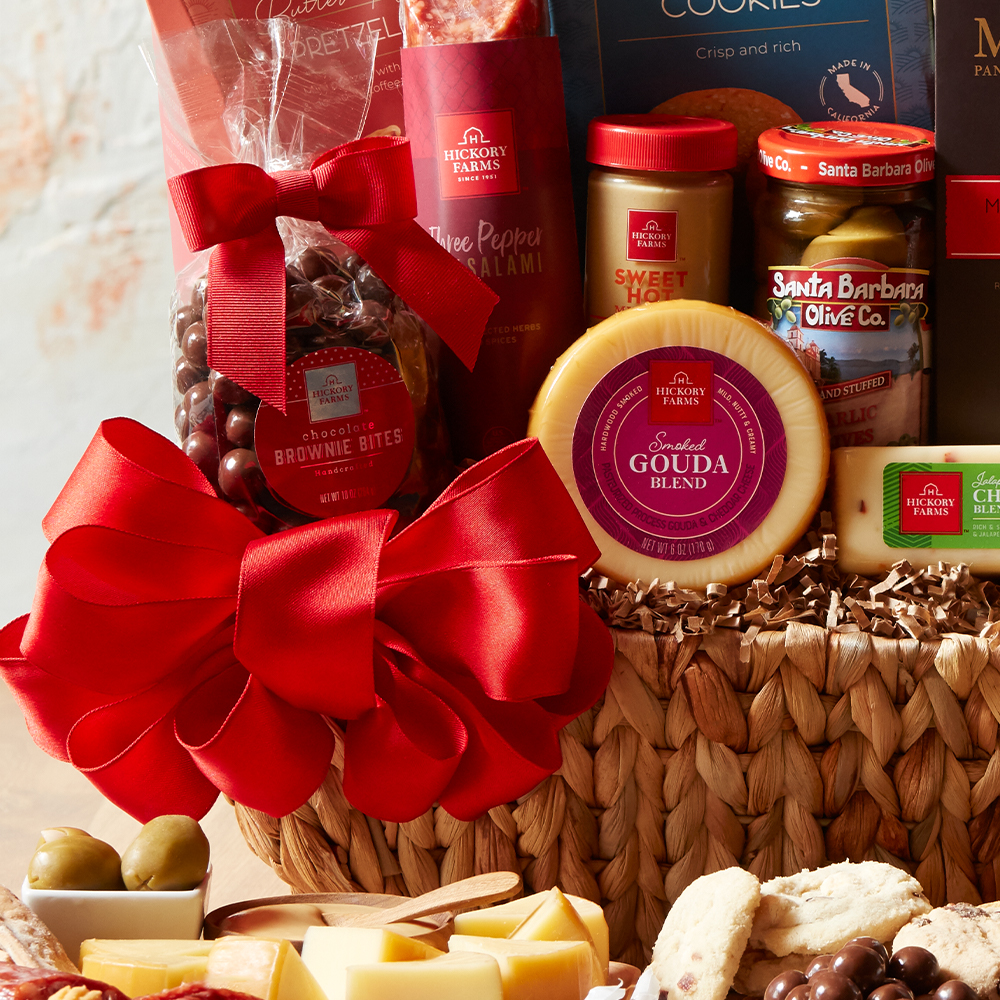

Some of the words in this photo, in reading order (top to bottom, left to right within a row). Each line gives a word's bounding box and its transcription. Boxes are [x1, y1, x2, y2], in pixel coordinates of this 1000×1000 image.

[696, 45, 735, 62] Crisp
[739, 42, 769, 56] and
[772, 39, 802, 54] rich
[443, 145, 508, 162] HICKORY
[452, 158, 501, 174] FARMS
[818, 161, 858, 177] Santa
[862, 162, 912, 178] Barbara
[477, 219, 543, 257] Pepper
[632, 231, 672, 241] HICKORY
[637, 239, 667, 249] FARMS
[614, 268, 688, 287] SWEET
[627, 287, 675, 304] HOT
[858, 305, 886, 327] Co.
[656, 387, 706, 397] HICKORY
[842, 376, 886, 396] STUFFED
[663, 397, 700, 406] FARMS
[274, 438, 352, 467] BROWNIE
[358, 428, 403, 453] BITES
[648, 431, 708, 452] Smoked
[629, 453, 729, 474] GOUDA
[650, 477, 707, 490] BLEND
[906, 498, 956, 508] HICKORY
[913, 507, 949, 517] FARMS
